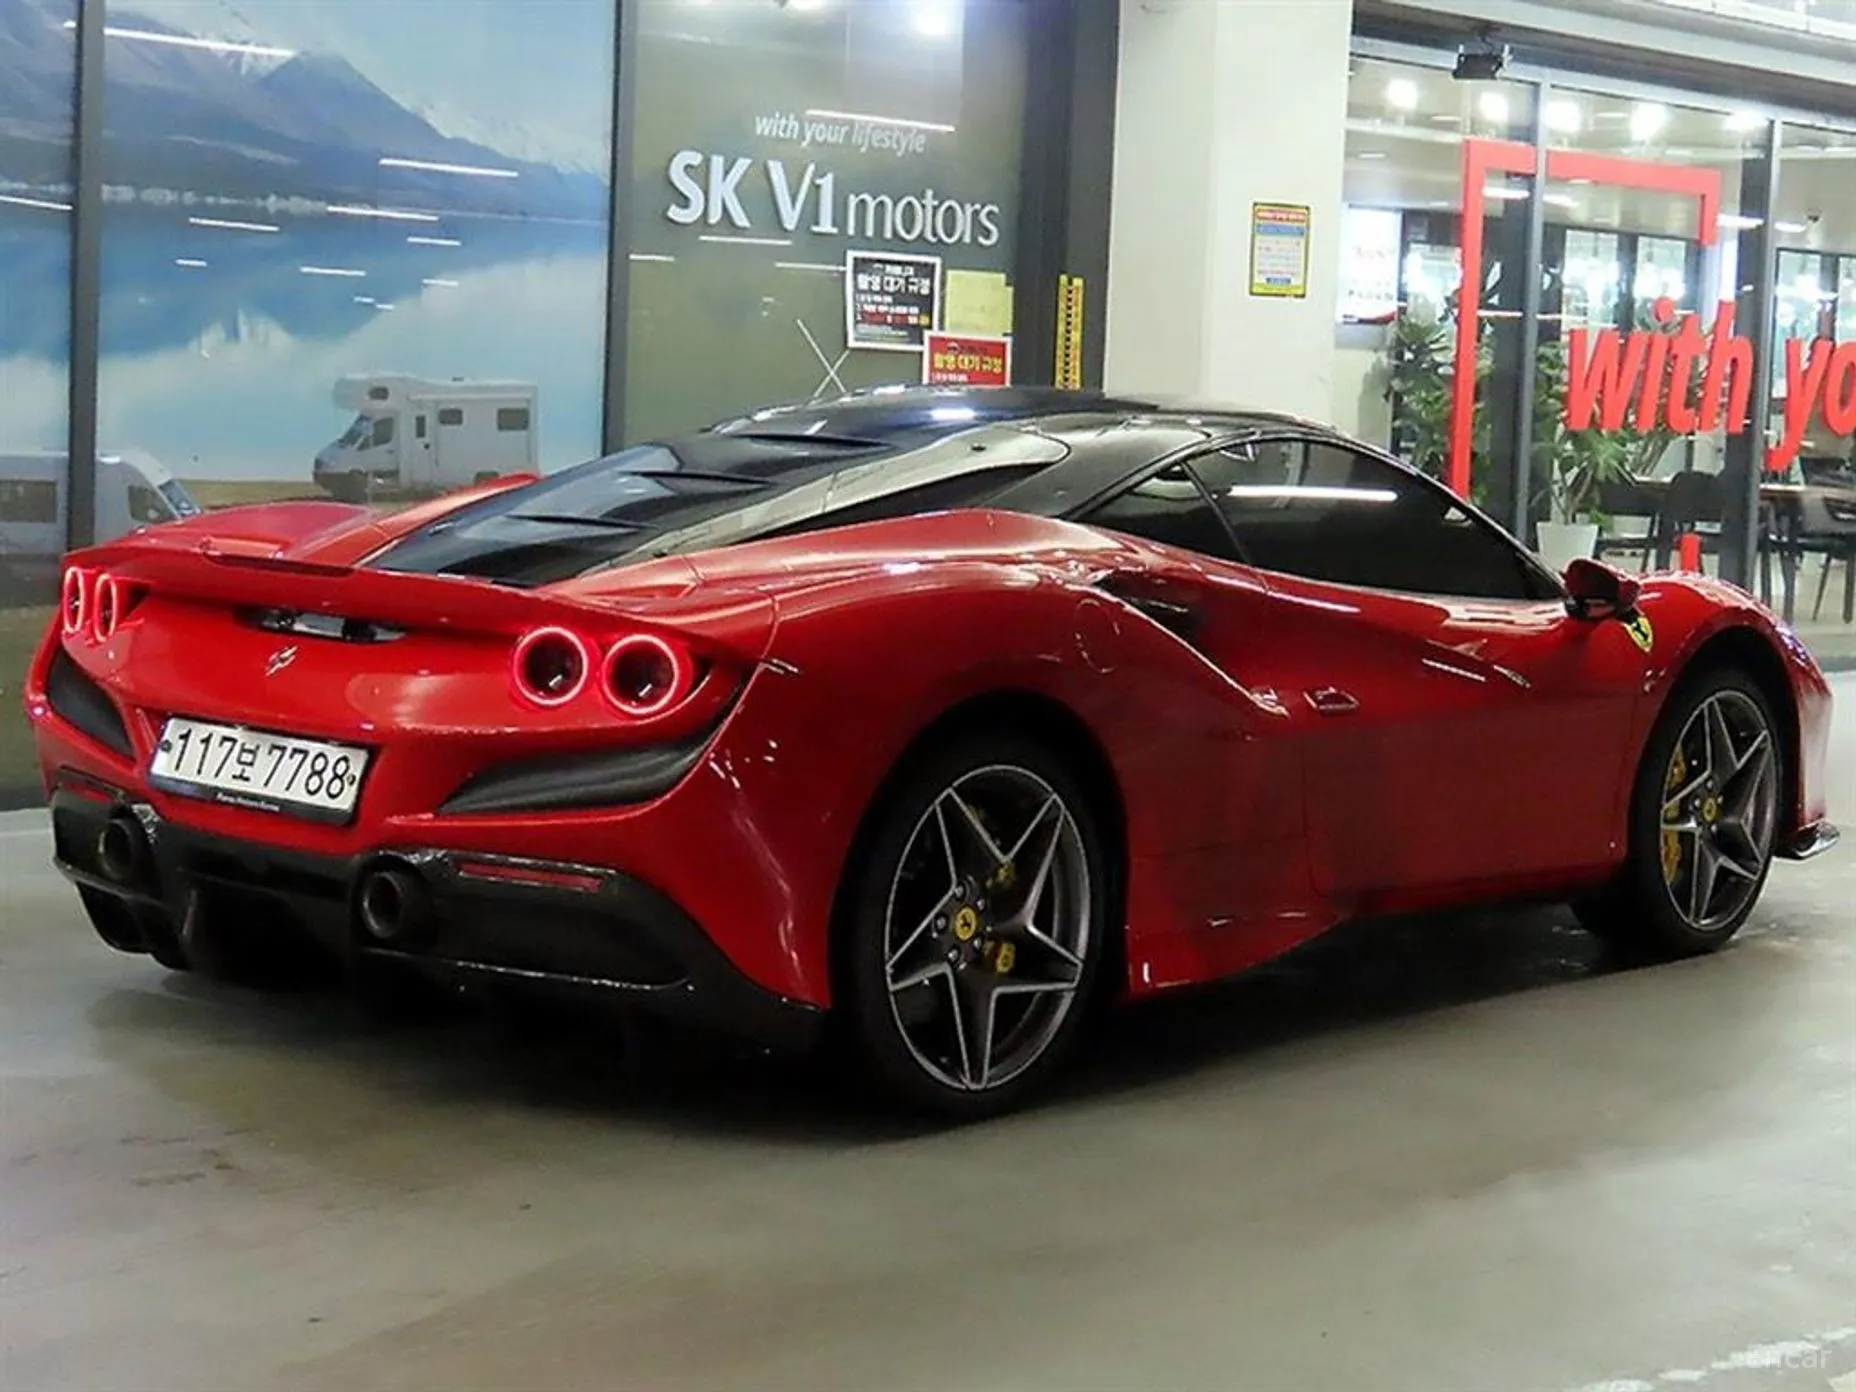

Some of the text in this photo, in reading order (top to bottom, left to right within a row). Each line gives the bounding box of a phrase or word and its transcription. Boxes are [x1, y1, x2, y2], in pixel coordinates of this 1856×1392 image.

[755, 111, 927, 157] with your lifestyle
[666, 149, 1000, 246] SK V1 motors
[1566, 296, 1856, 472] with yo
